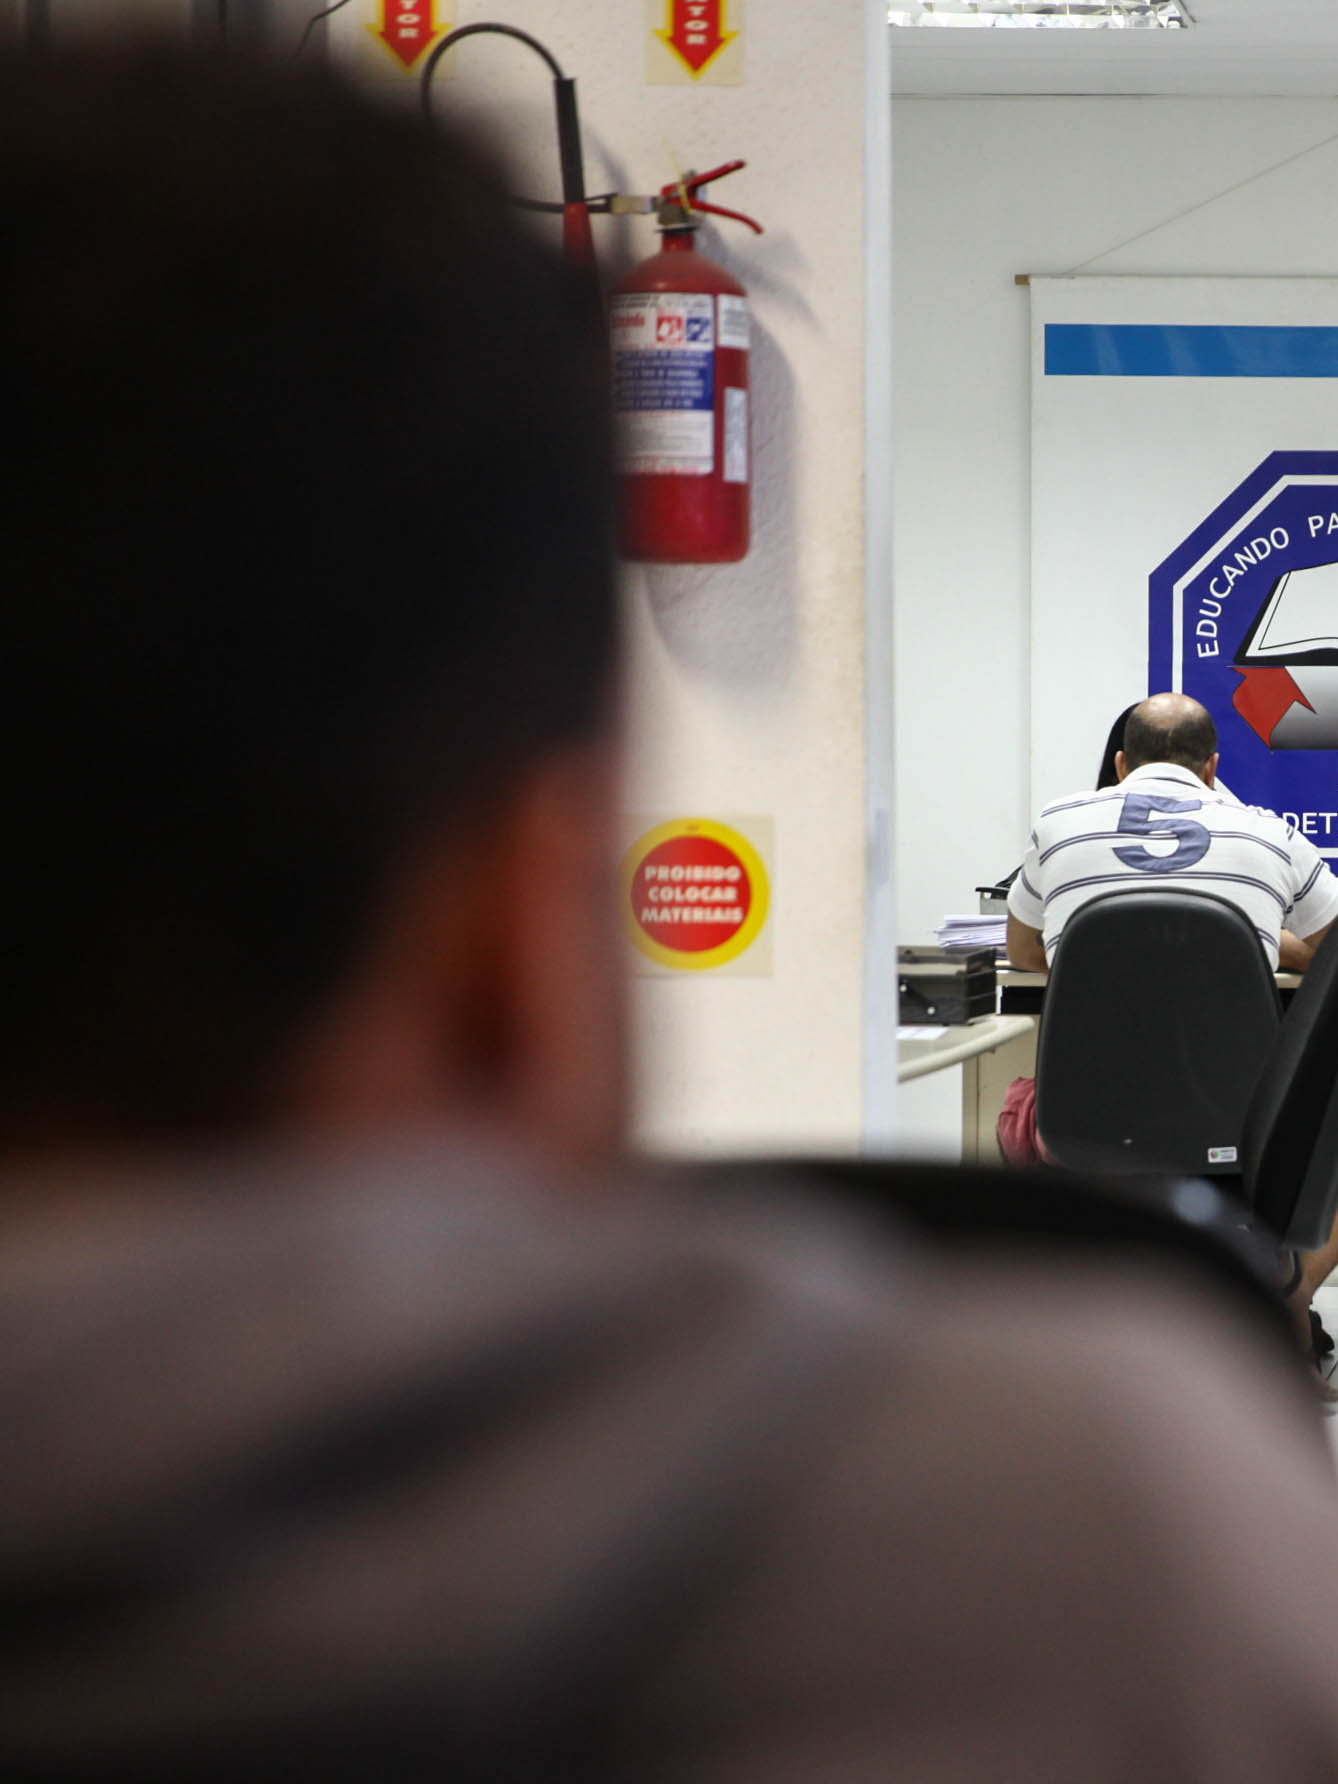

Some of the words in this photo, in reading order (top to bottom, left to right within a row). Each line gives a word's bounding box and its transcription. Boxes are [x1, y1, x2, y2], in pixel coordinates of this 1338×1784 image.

[684, 0, 709, 45] TOR
[1196, 527, 1290, 658] EDUCANDO
[1112, 792, 1211, 872] 5
[645, 865, 741, 882] PROIBIDO
[648, 886, 738, 903] COLOCAR
[641, 906, 743, 923] MATERIAIS
